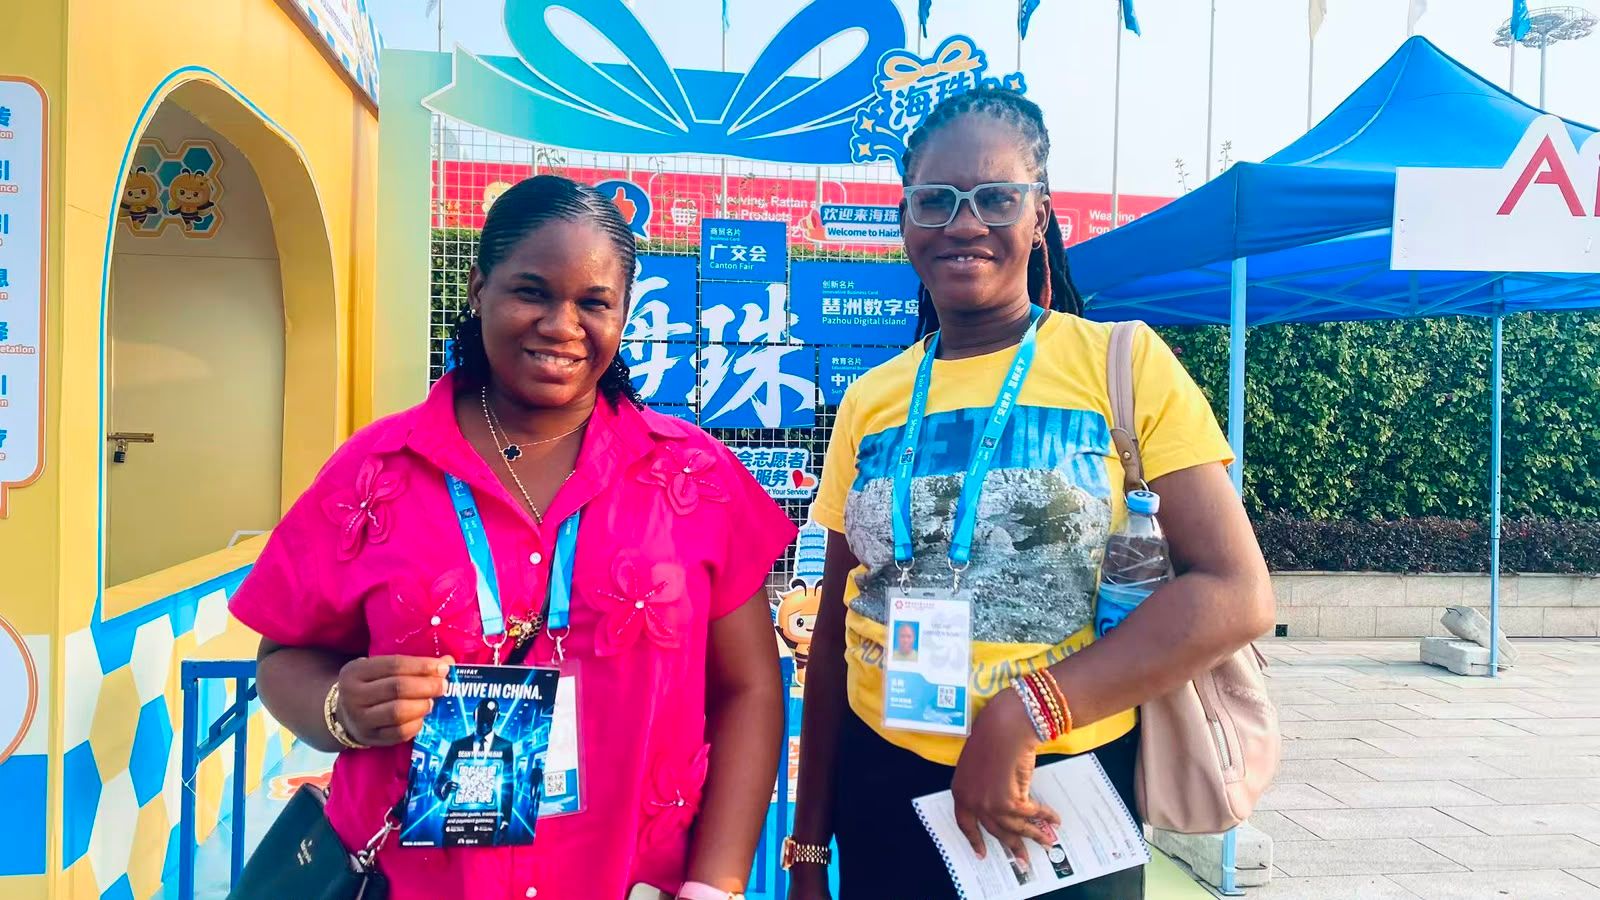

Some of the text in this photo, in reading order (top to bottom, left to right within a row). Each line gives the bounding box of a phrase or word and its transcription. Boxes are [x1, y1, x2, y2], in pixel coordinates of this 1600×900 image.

[770, 196, 808, 208] Rattan
[741, 209, 792, 222] Products
[823, 207, 899, 222] 欢迎来海珠
[1089, 209, 1135, 222] Weaing
[828, 227, 867, 237] Welcome
[869, 229, 877, 237] to
[710, 243, 768, 262] 广交会
[710, 261, 754, 270] Canton Fair
[822, 280, 855, 289] 创新名片
[822, 298, 919, 316] 琶洲数字岛
[822, 316, 907, 327] Pazhou Digital Island
[831, 357, 862, 366] 教育名片
[733, 450, 805, 468] 会志愿者
[787, 488, 809, 496] Service
[444, 681, 543, 700] URVIVE IN CHINA.
